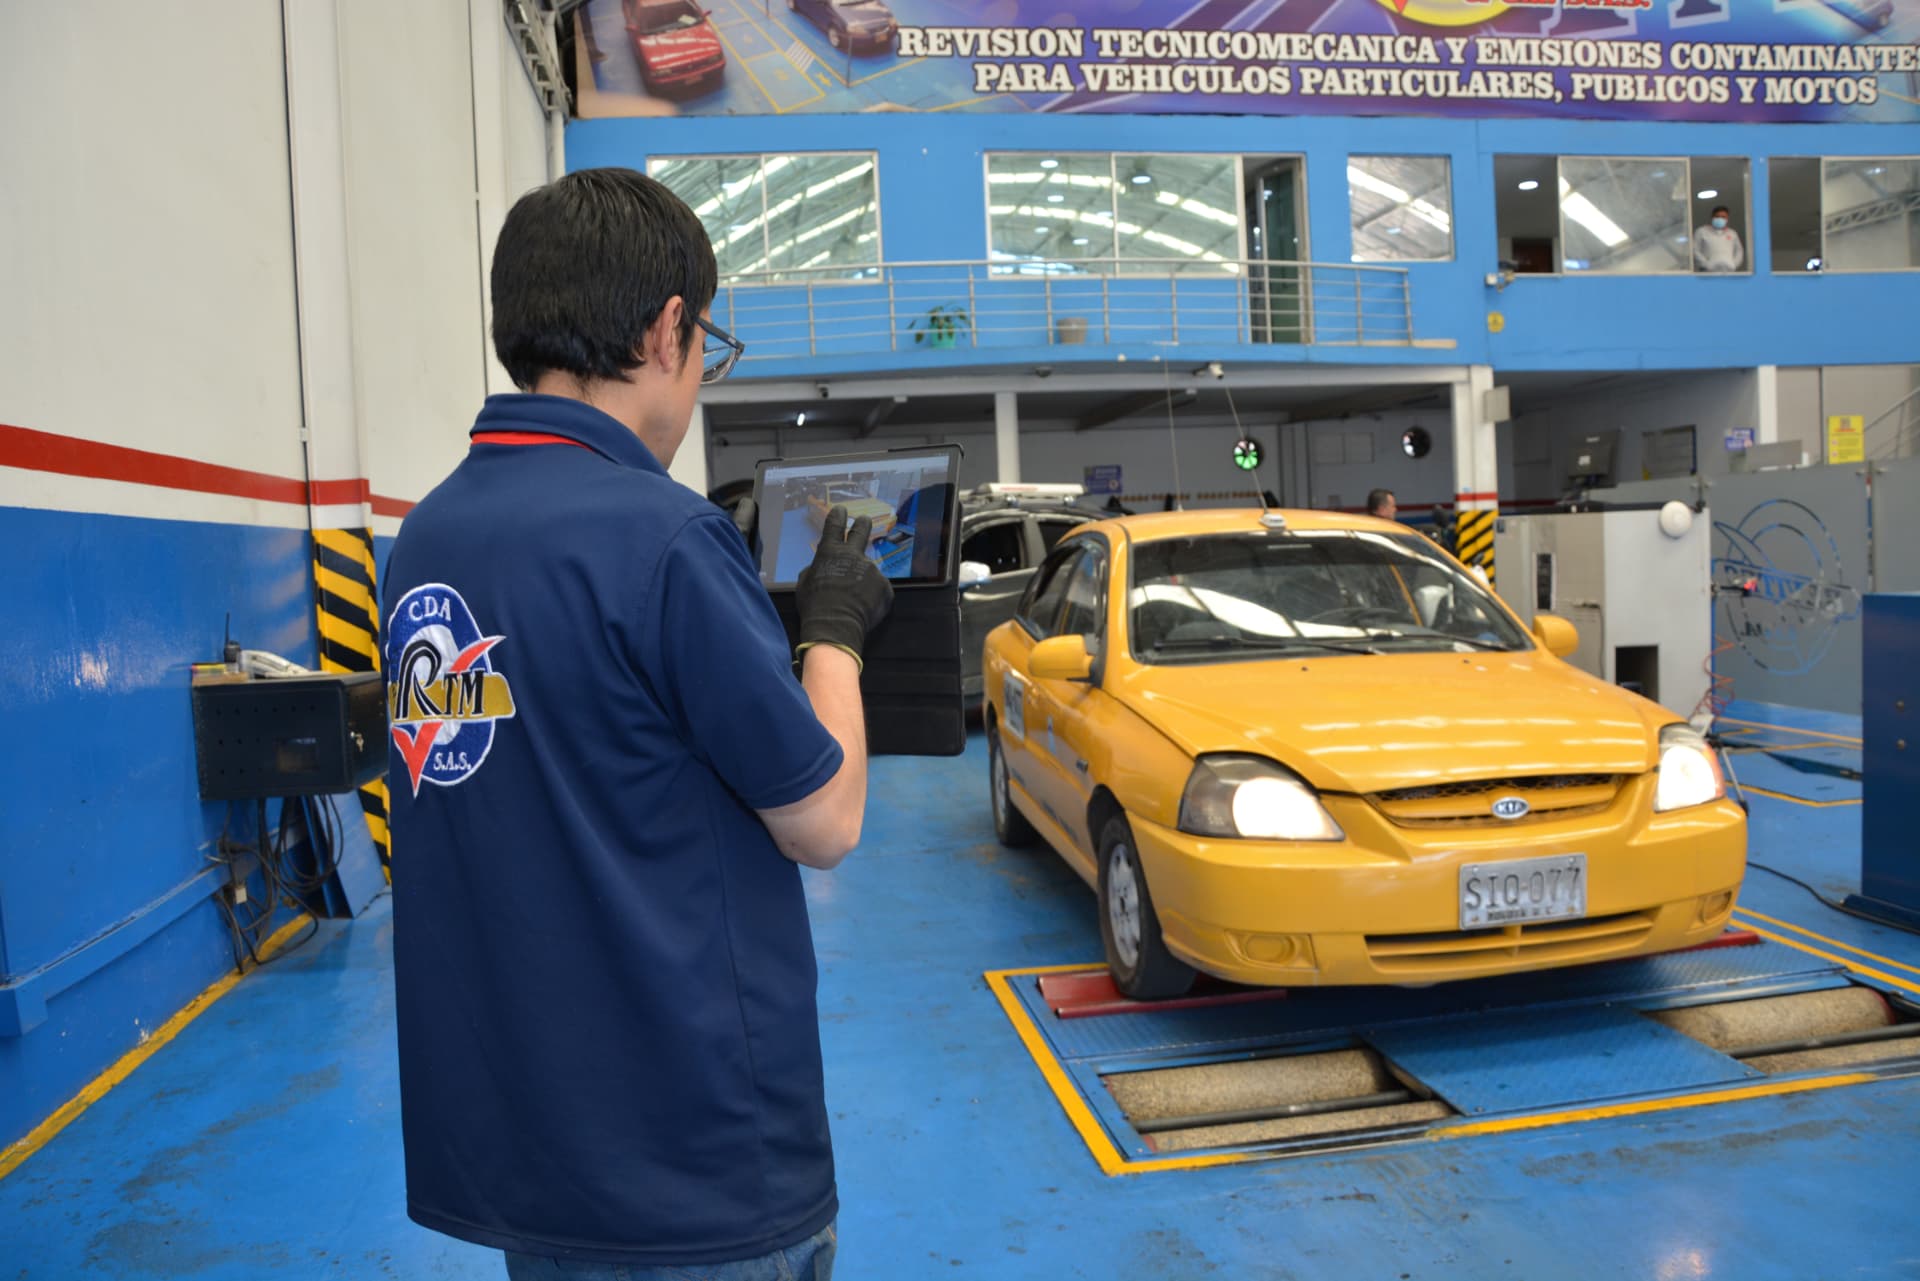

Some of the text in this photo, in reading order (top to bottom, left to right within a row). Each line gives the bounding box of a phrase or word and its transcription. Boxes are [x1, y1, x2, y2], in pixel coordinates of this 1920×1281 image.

[898, 27, 1920, 72] REVISION TECNICOMECANICA Y EMISIONES CONTAMINANTE
[973, 63, 1877, 104] PARA VEHICULOS PARTICULARES, PUBLICOS Y MOTOS
[408, 595, 452, 622] CDA
[433, 751, 472, 771] S.A.S.
